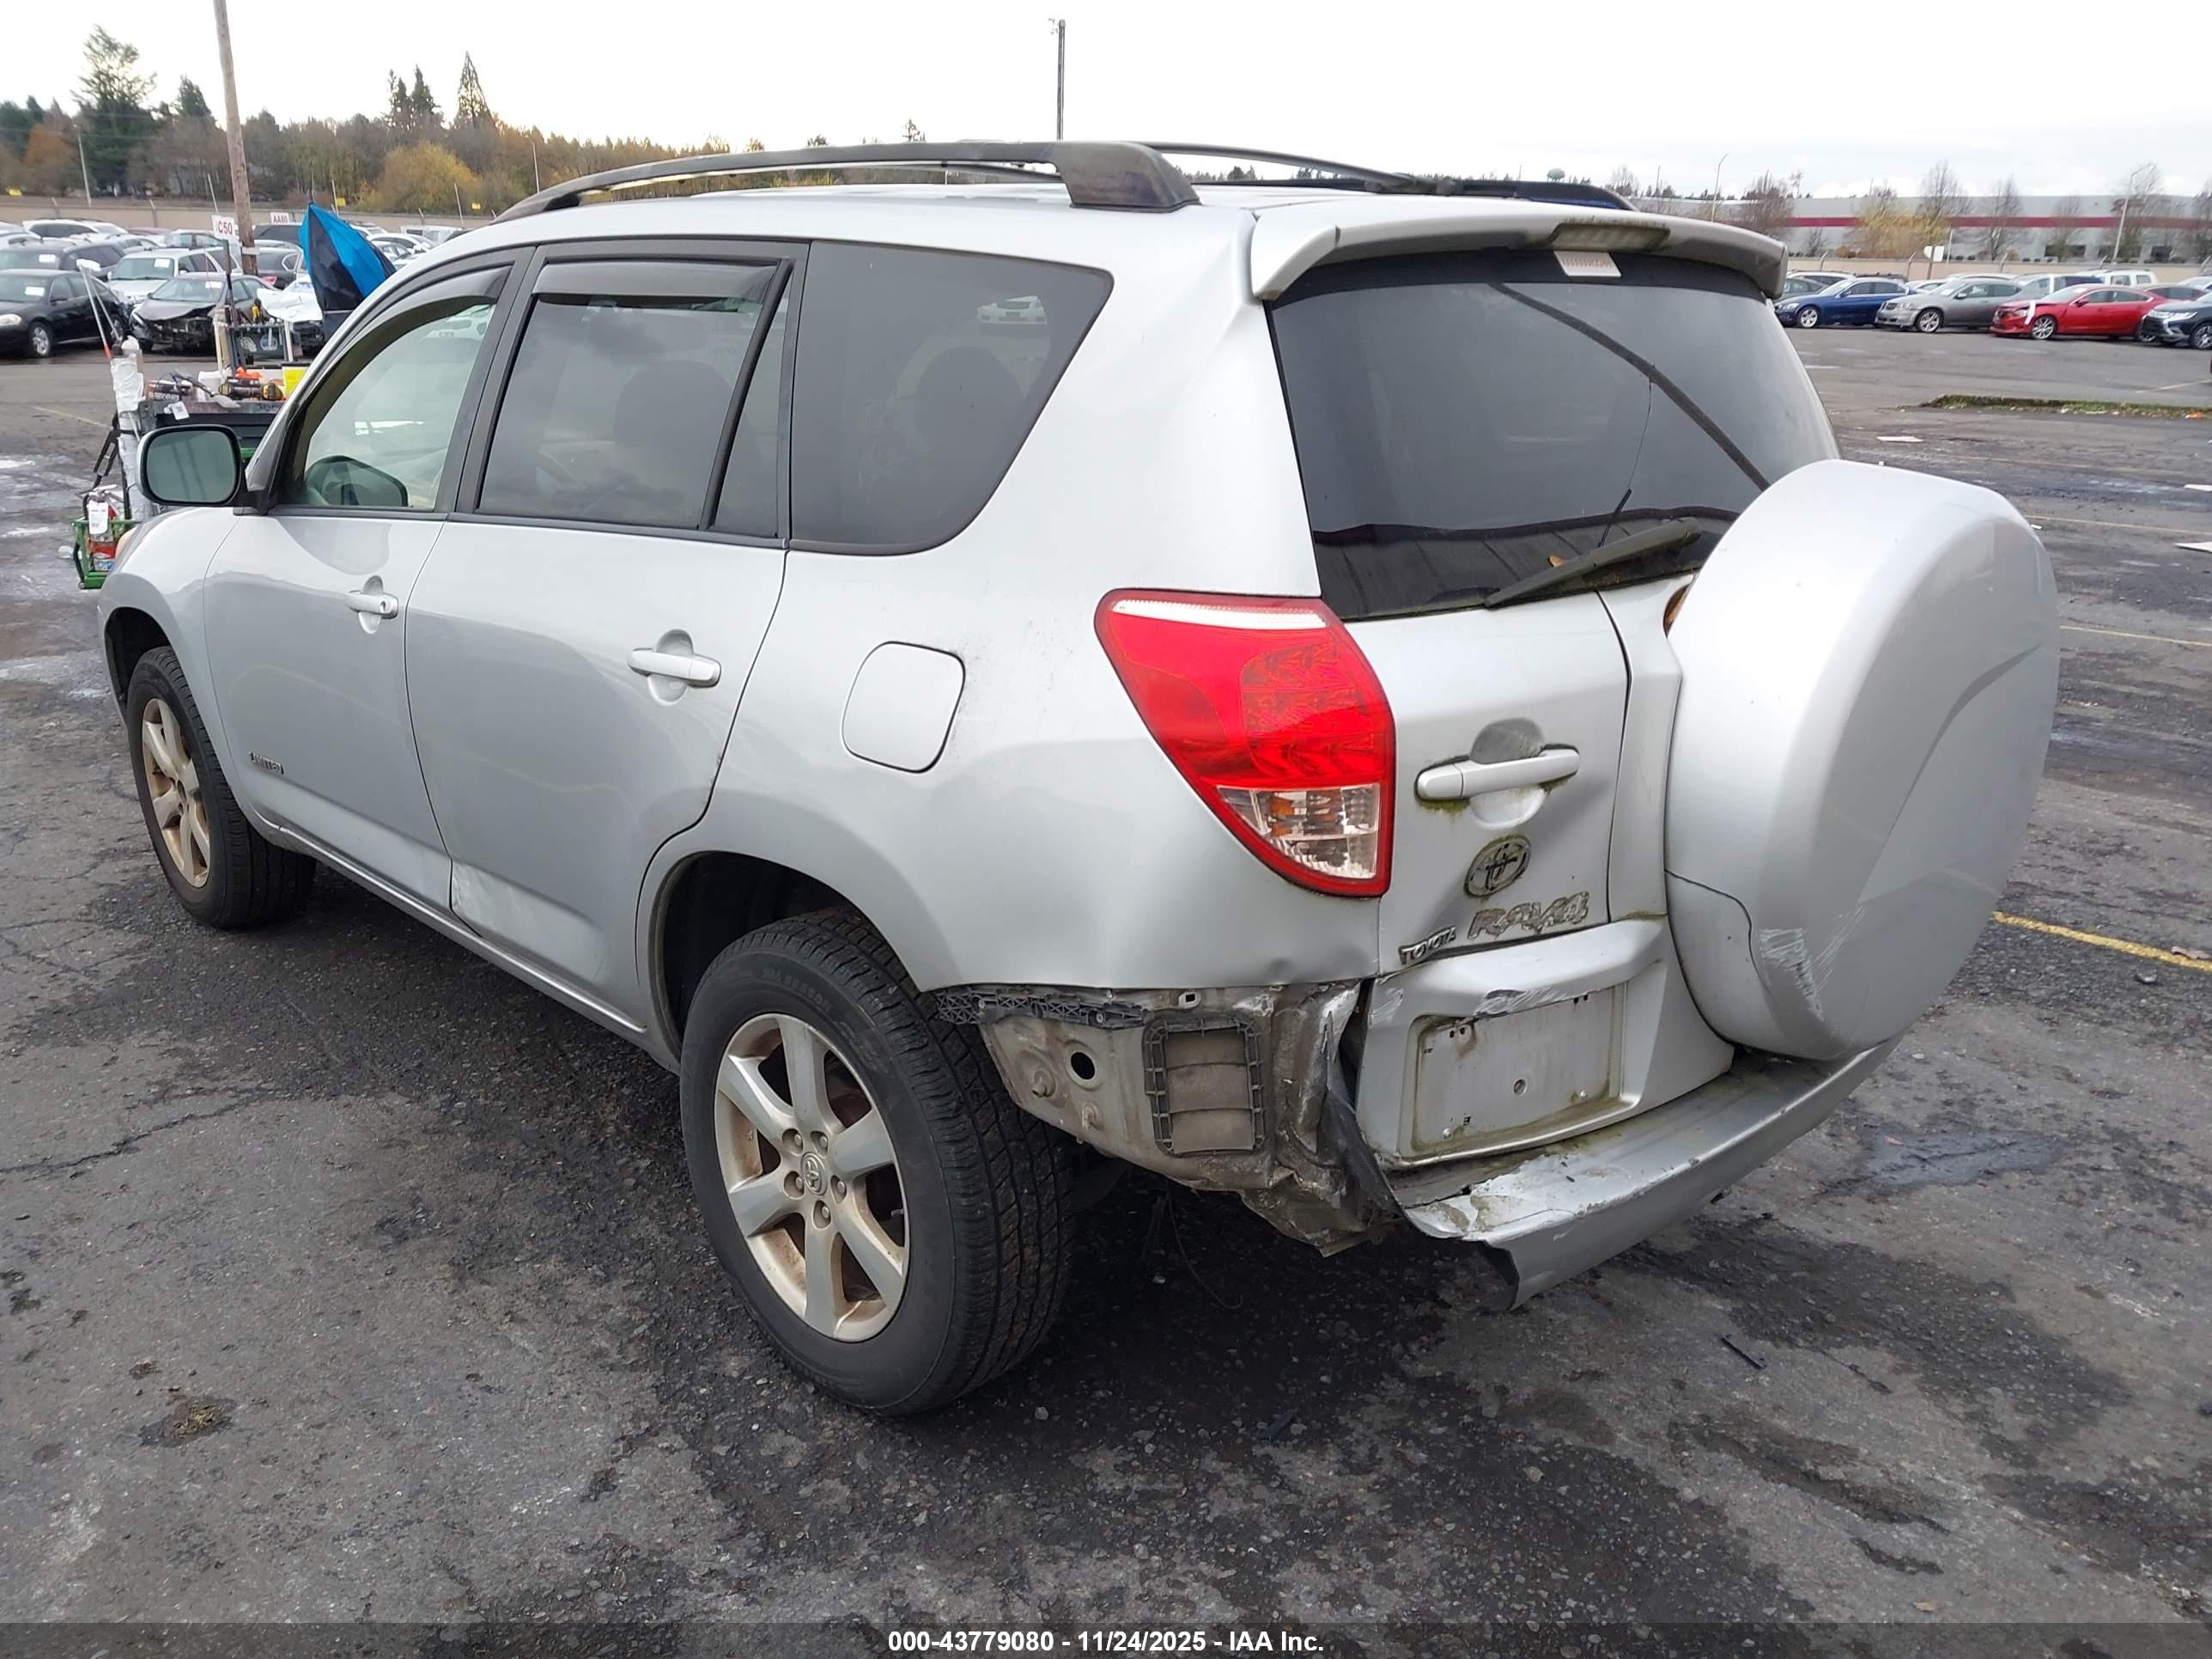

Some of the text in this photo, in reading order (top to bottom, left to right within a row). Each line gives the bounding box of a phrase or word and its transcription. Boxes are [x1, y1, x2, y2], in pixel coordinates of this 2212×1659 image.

[217, 220, 233, 235] C50
[1467, 891, 1589, 941] RAV4
[1398, 925, 1457, 966] TOYOTA
